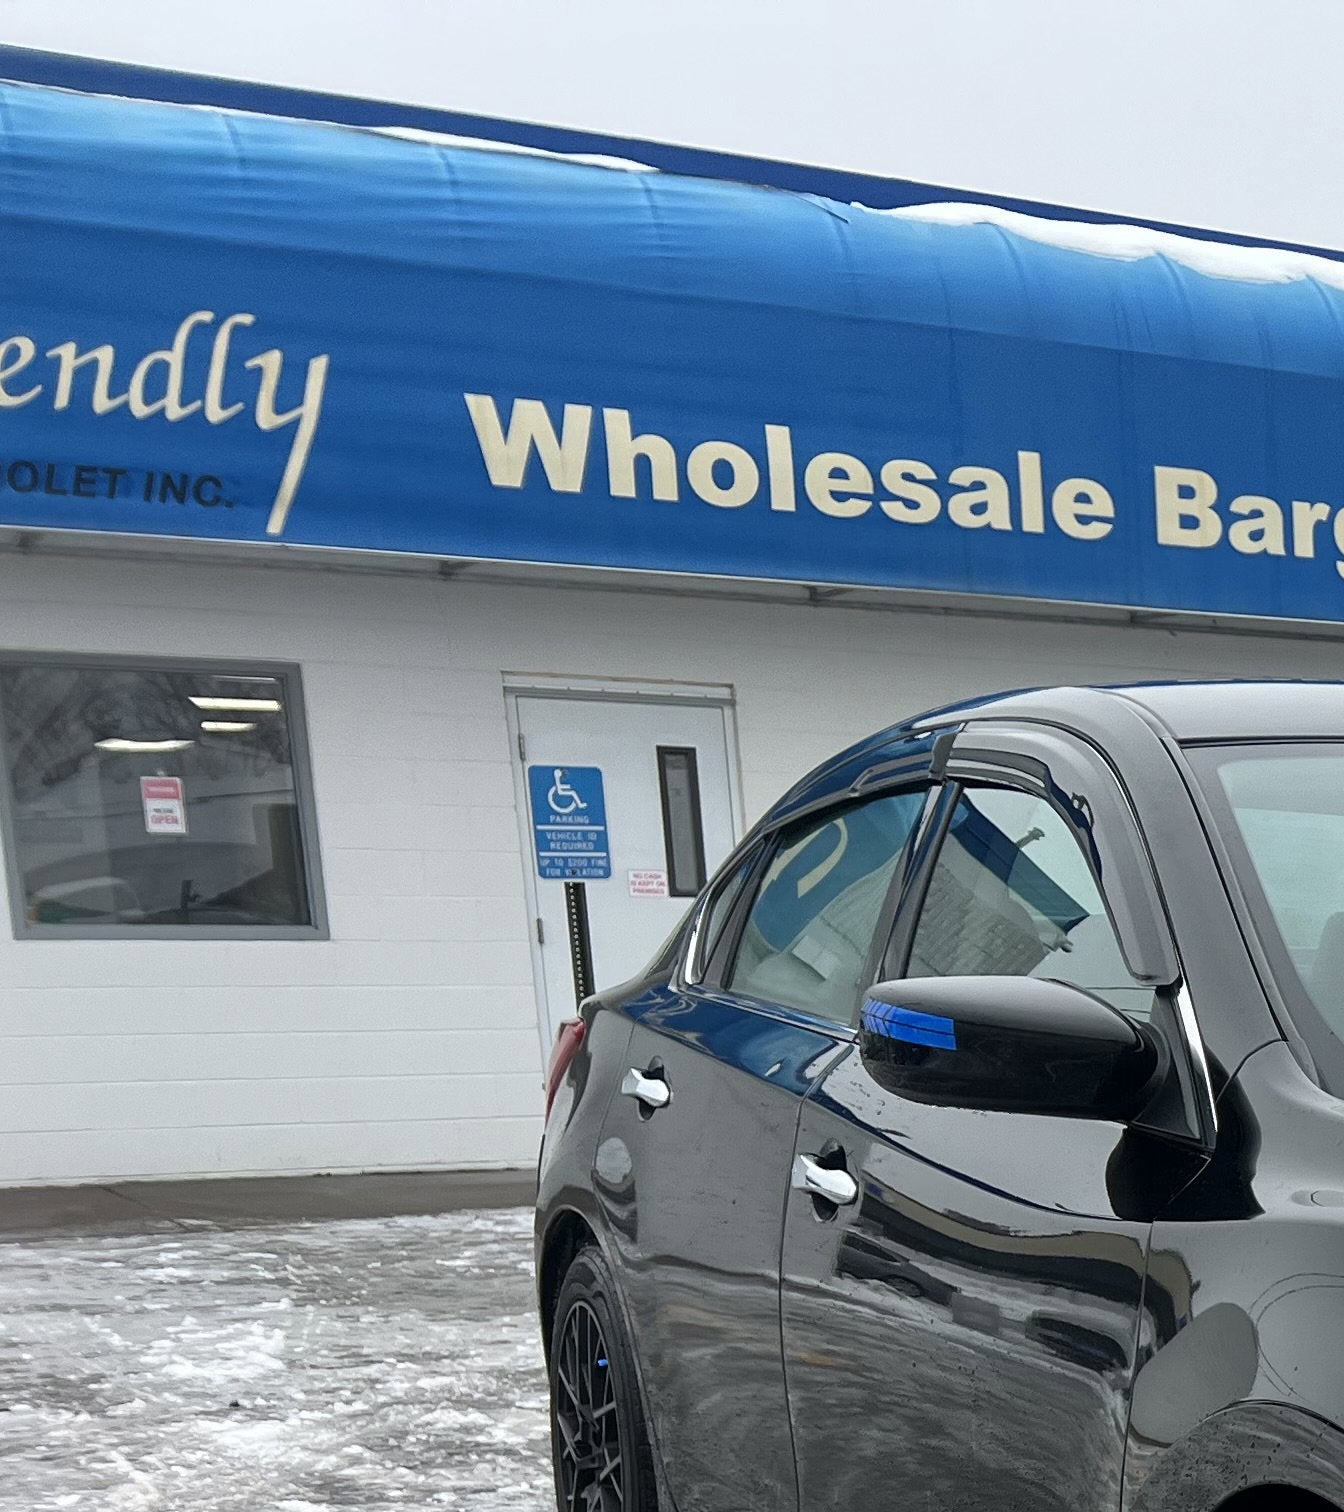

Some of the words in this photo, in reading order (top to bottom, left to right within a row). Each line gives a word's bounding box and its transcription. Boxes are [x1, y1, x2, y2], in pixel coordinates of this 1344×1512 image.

[463, 393, 1115, 541] Wholesale
[143, 469, 235, 509] INC.
[149, 814, 178, 825] OPEN
[549, 815, 590, 824] PARKING
[545, 832, 583, 840] VEHICLE
[588, 832, 597, 841] ID
[550, 841, 594, 850] REQUIRED
